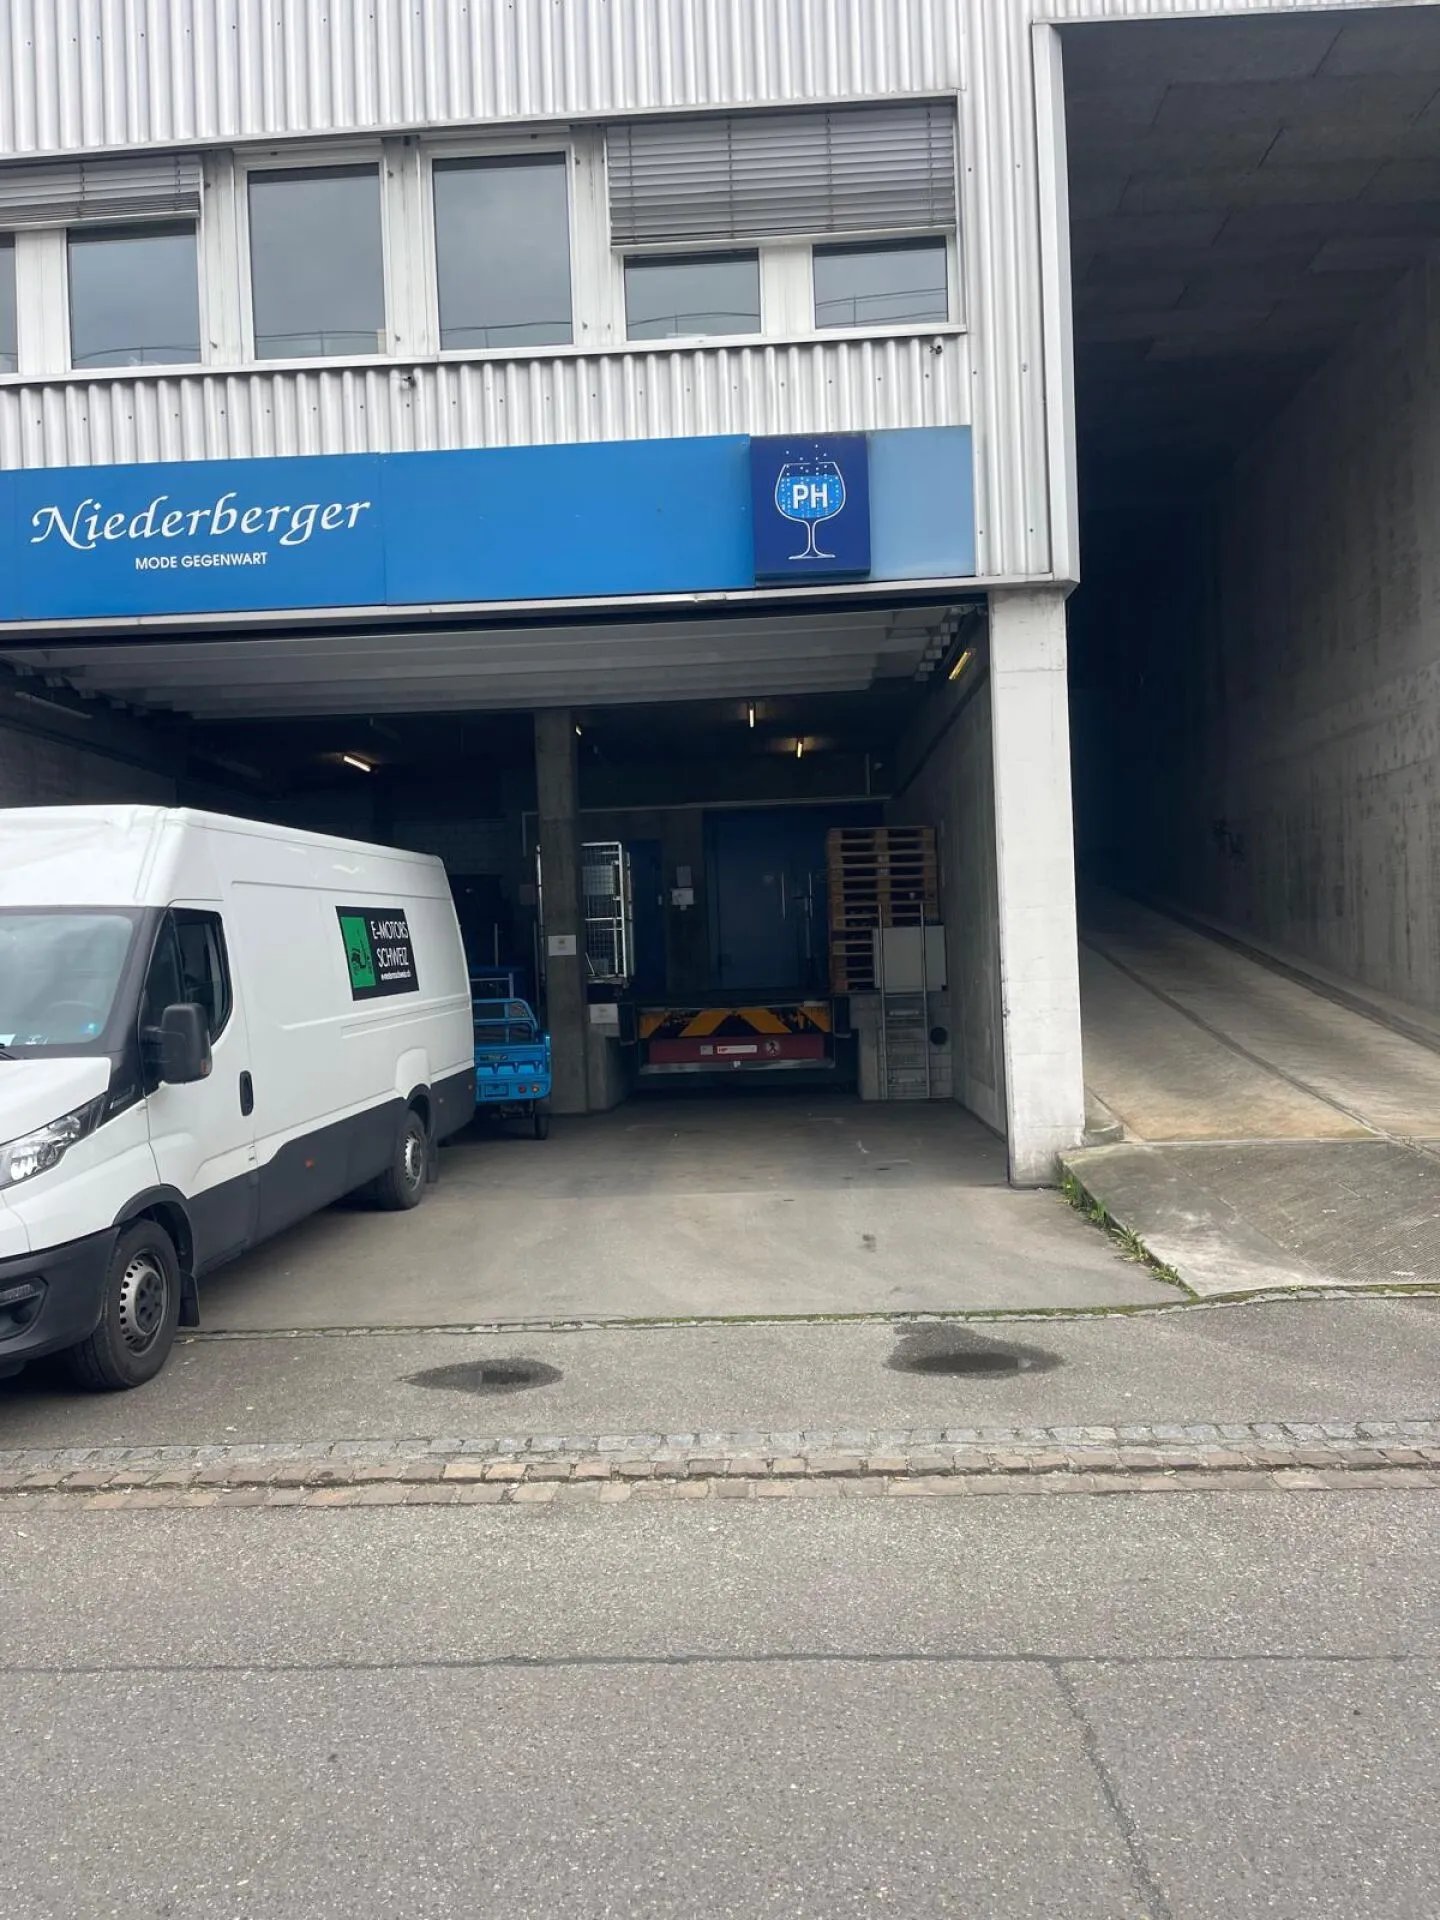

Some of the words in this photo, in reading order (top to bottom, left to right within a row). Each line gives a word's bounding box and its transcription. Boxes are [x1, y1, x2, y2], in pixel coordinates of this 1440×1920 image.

[792, 483, 828, 509] PH
[30, 492, 371, 549] Niederberger
[135, 556, 178, 570] MODE
[181, 552, 268, 568] GEGENWART
[370, 920, 409, 939] E-MOTORS
[376, 946, 410, 968] SCHWEIZ
